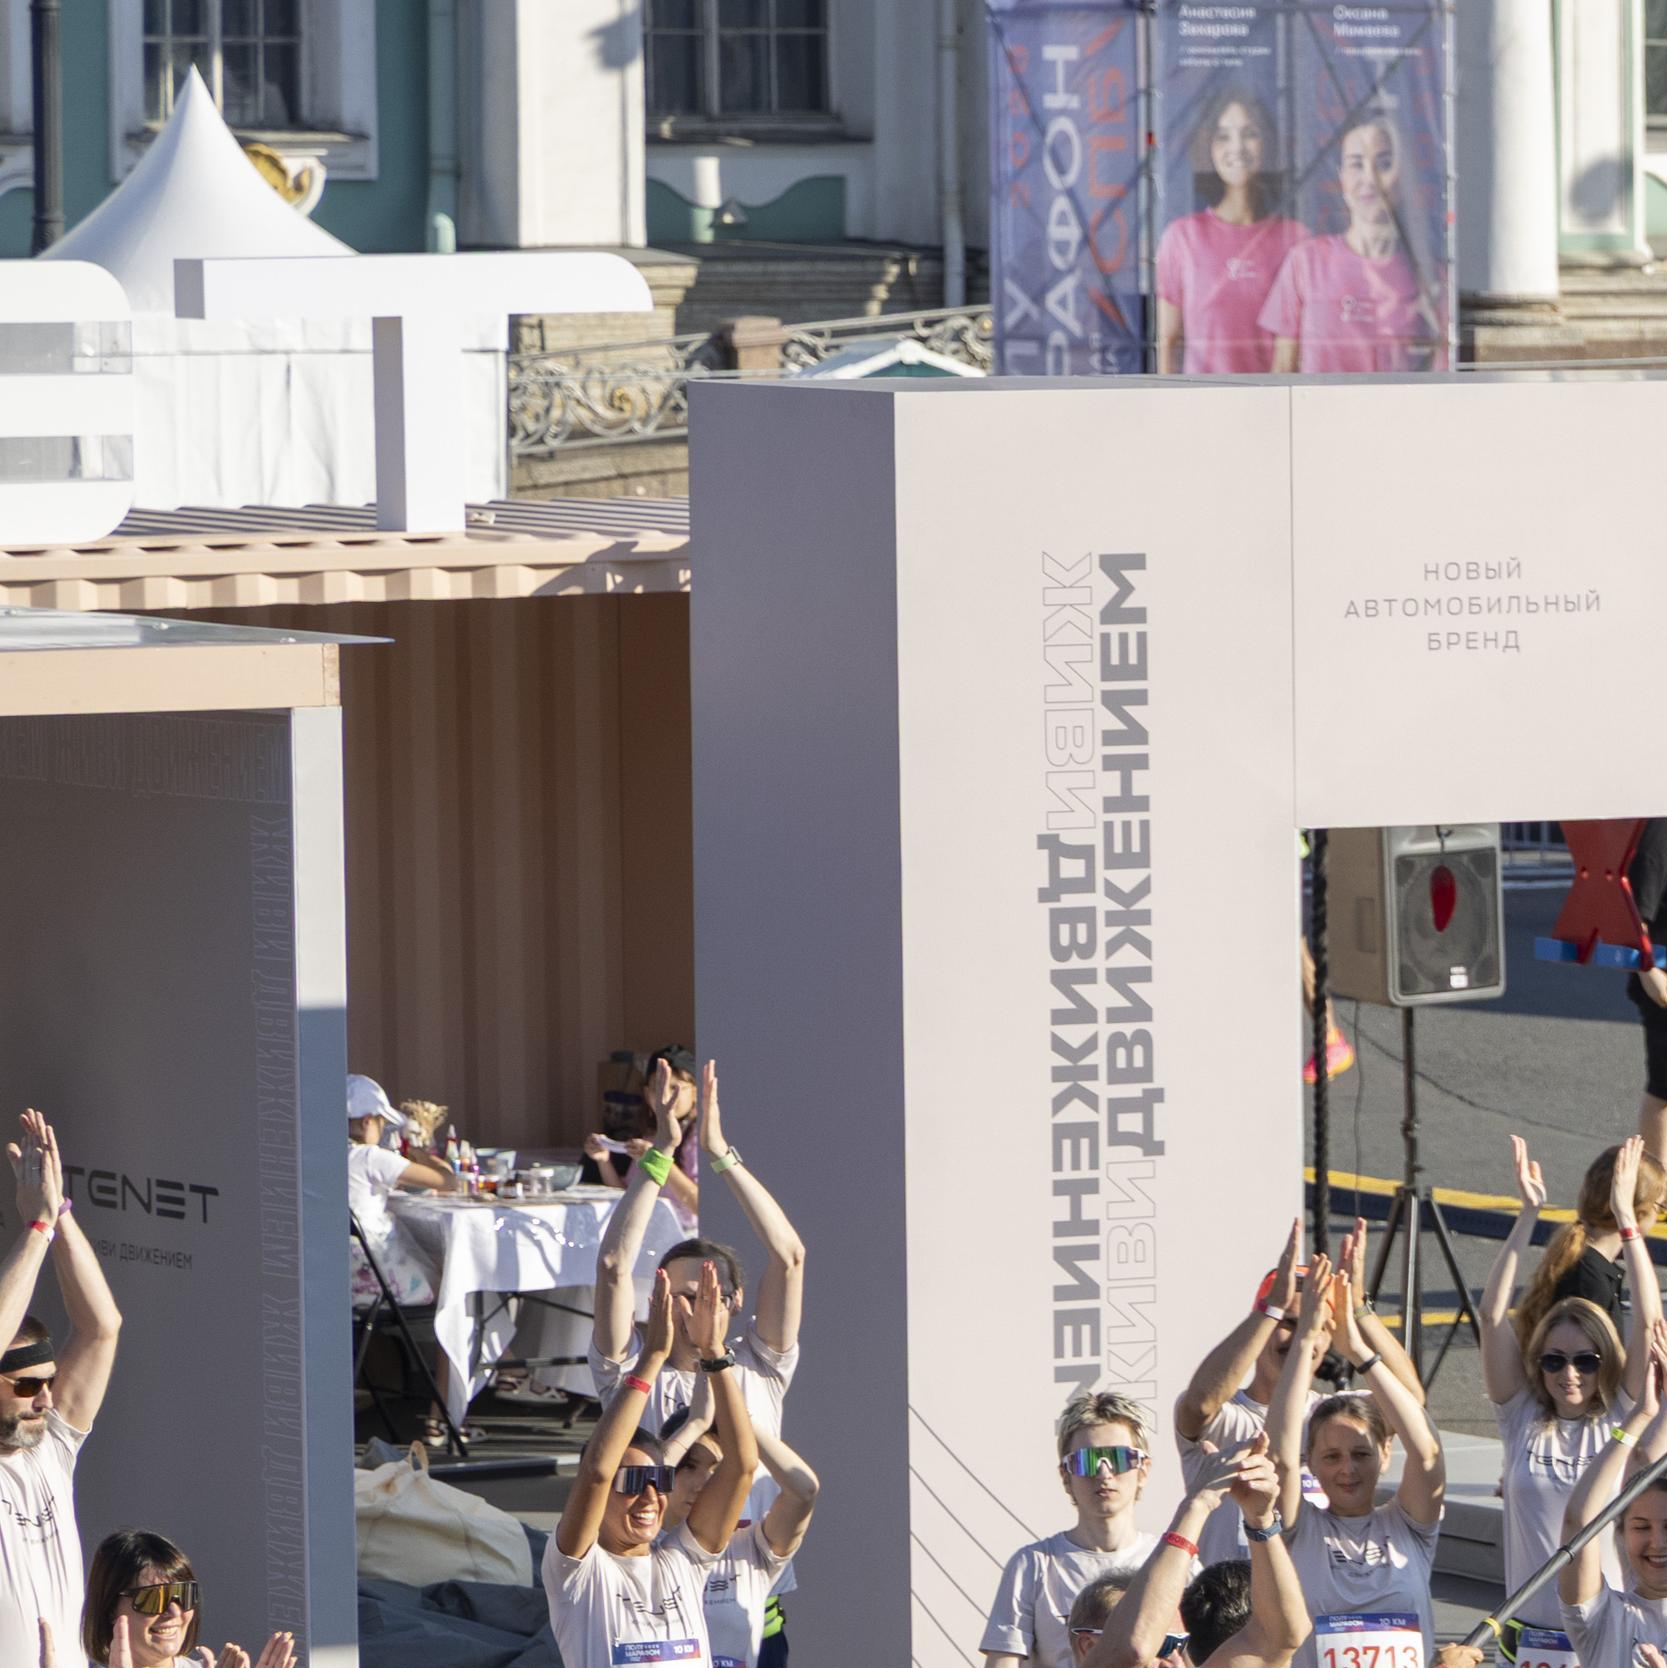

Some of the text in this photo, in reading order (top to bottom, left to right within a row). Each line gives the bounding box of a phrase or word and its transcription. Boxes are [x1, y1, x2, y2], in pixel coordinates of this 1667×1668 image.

[1042, 45, 1083, 375] РАФОН
[1423, 556, 1524, 582] НОВЫЙ
[1343, 589, 1603, 619] АВТОМОБИЛЬНЫЙ
[1426, 630, 1521, 653] БРЕНД
[1041, 550, 1096, 830] ЖИВИ
[1098, 552, 1166, 1157] ДВИЖЕНИЕМ
[61, 1164, 221, 1224] TENET
[119, 1242, 194, 1271] ДВИЖЕНИЕМ
